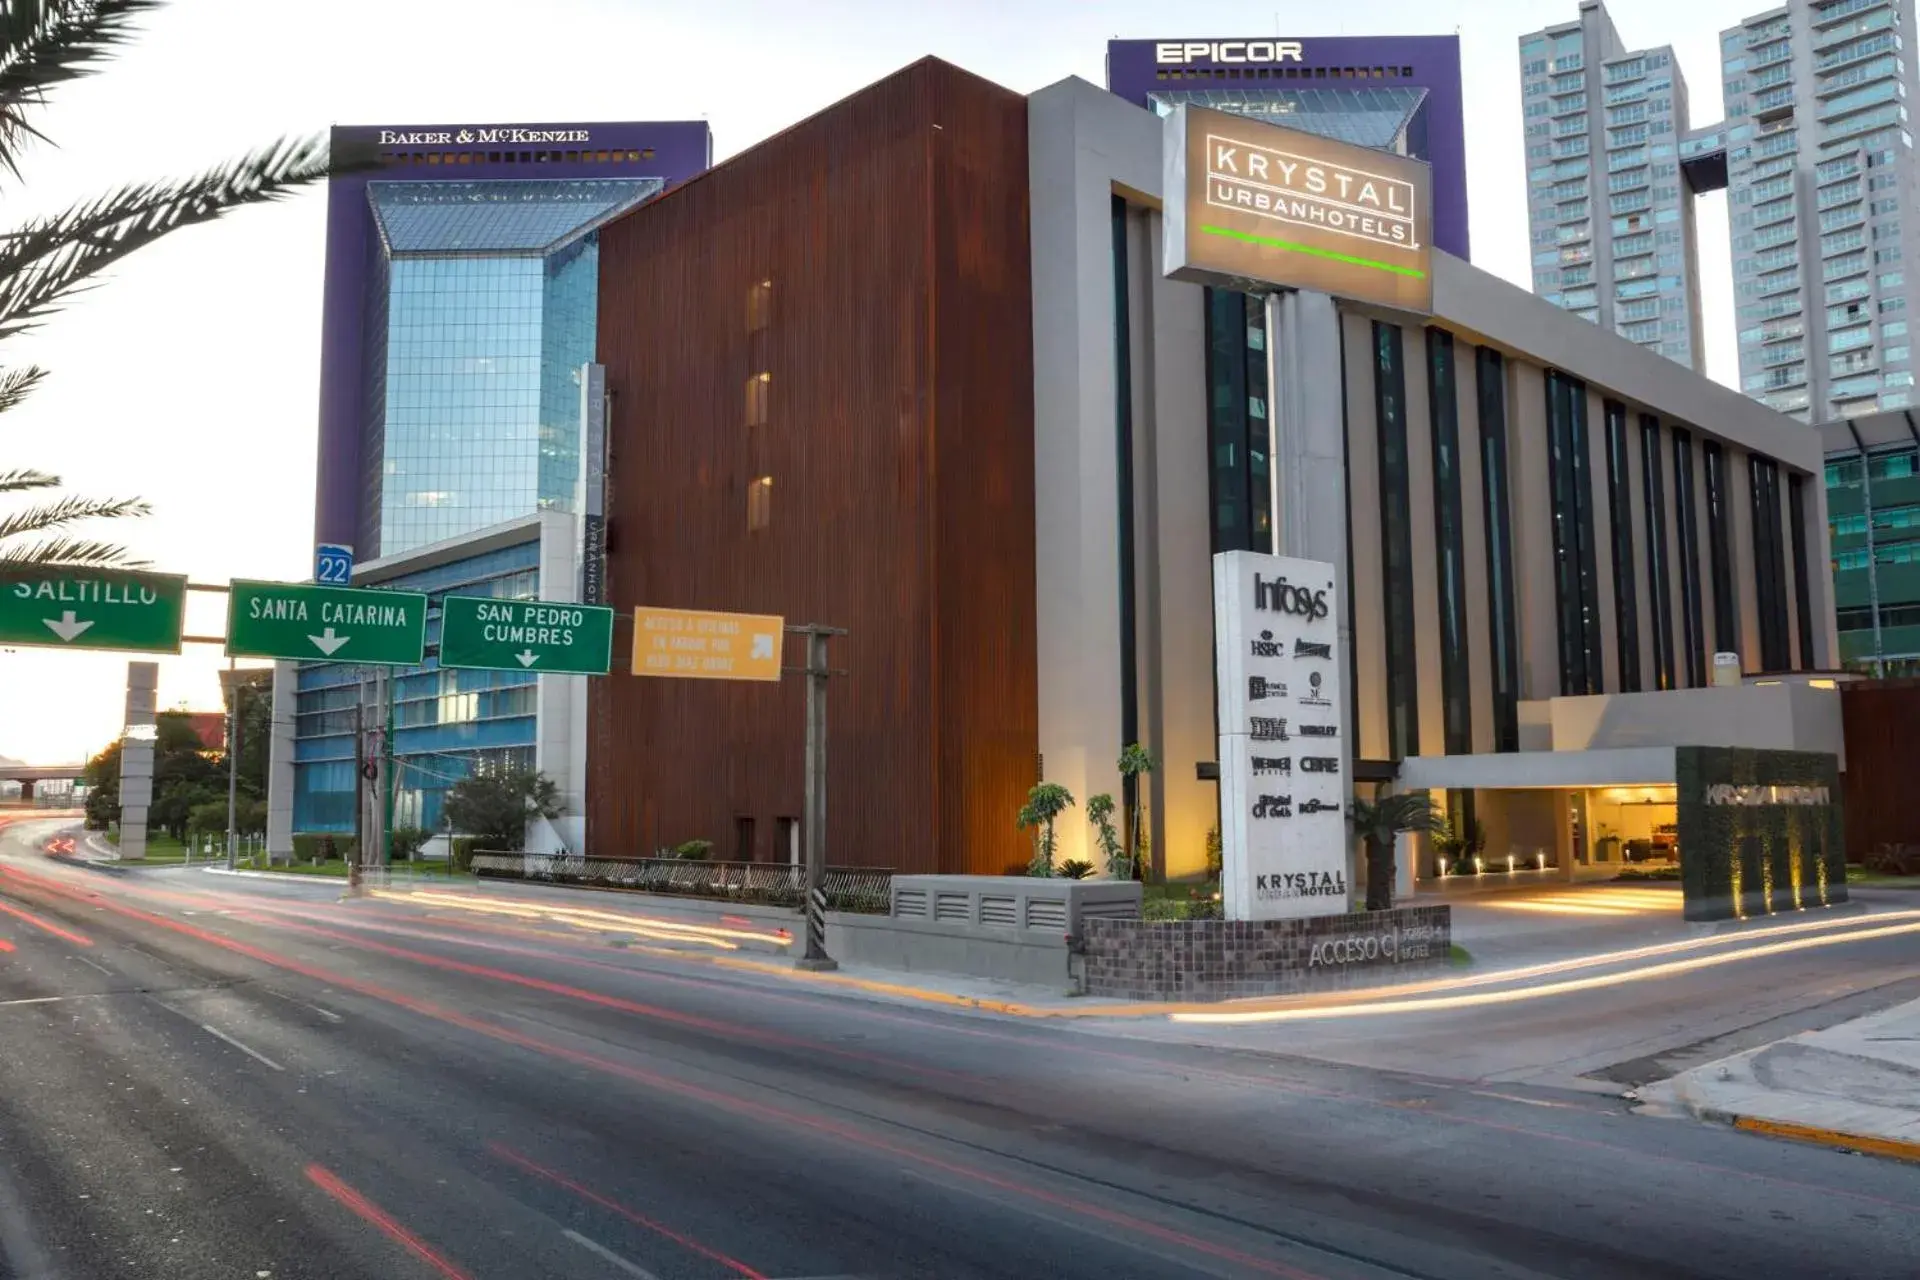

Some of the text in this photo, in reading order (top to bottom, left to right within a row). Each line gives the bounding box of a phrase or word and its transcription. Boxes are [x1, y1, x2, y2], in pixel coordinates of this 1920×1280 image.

[1156, 42, 1303, 64] EPICOR
[378, 129, 451, 145] BAKER
[456, 129, 475, 144] &
[1216, 145, 1405, 212] KRYSTAL
[1217, 185, 1405, 240] URBANHOTELS
[319, 557, 347, 582] 22
[1254, 572, 1329, 623] Infosys
[249, 597, 407, 628] SANTA CATARINA
[476, 604, 584, 628] SAN PEDRO
[483, 624, 574, 646] CUMBRES
[1250, 640, 1284, 657] HSBC
[1256, 870, 1345, 890] KRYSTAL
[1308, 936, 1378, 967] ACCESO
